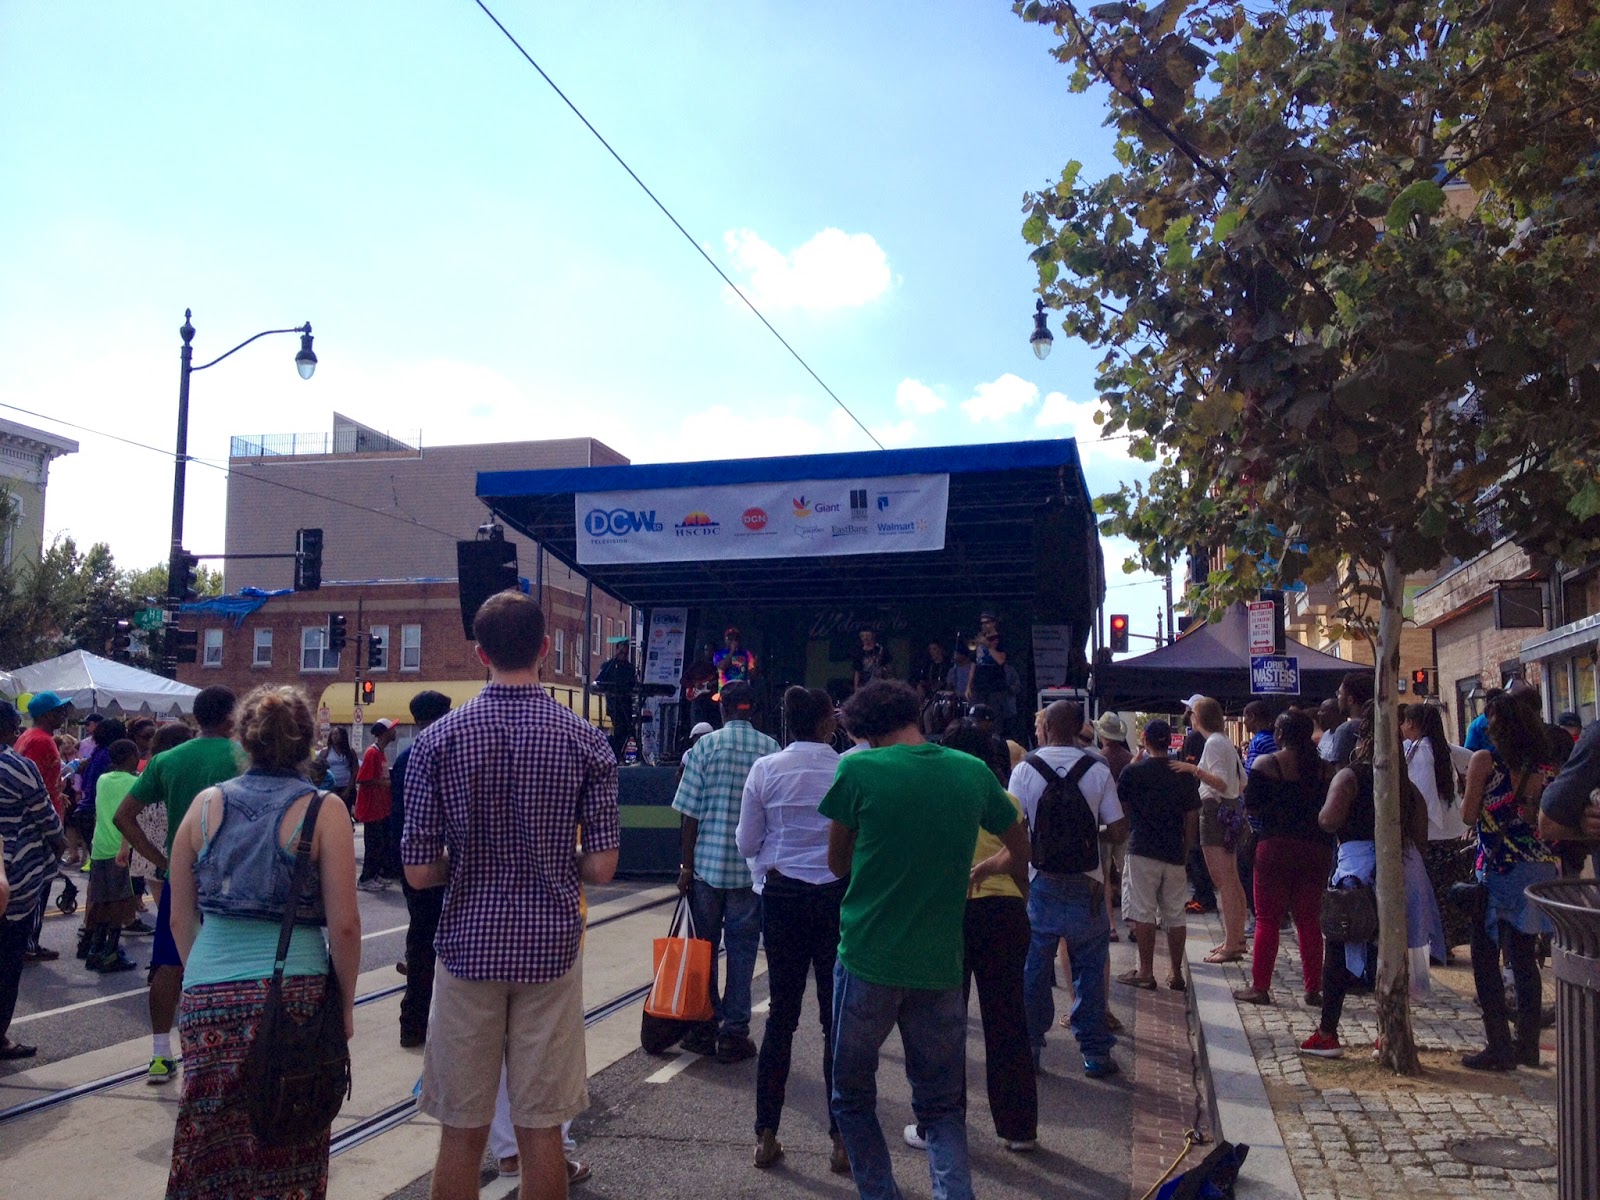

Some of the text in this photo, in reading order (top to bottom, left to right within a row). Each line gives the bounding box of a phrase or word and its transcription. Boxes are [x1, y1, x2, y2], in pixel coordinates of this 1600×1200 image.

[815, 503, 840, 513] Giant
[744, 514, 766, 524] DCN
[675, 527, 721, 537] HSCDC
[832, 524, 869, 535] EastBanc
[877, 521, 915, 533] Walmart
[141, 614, 149, 623] 4
[149, 609, 156, 619] H
[1263, 661, 1285, 669] LORIE
[1253, 669, 1297, 683] MASTERS
